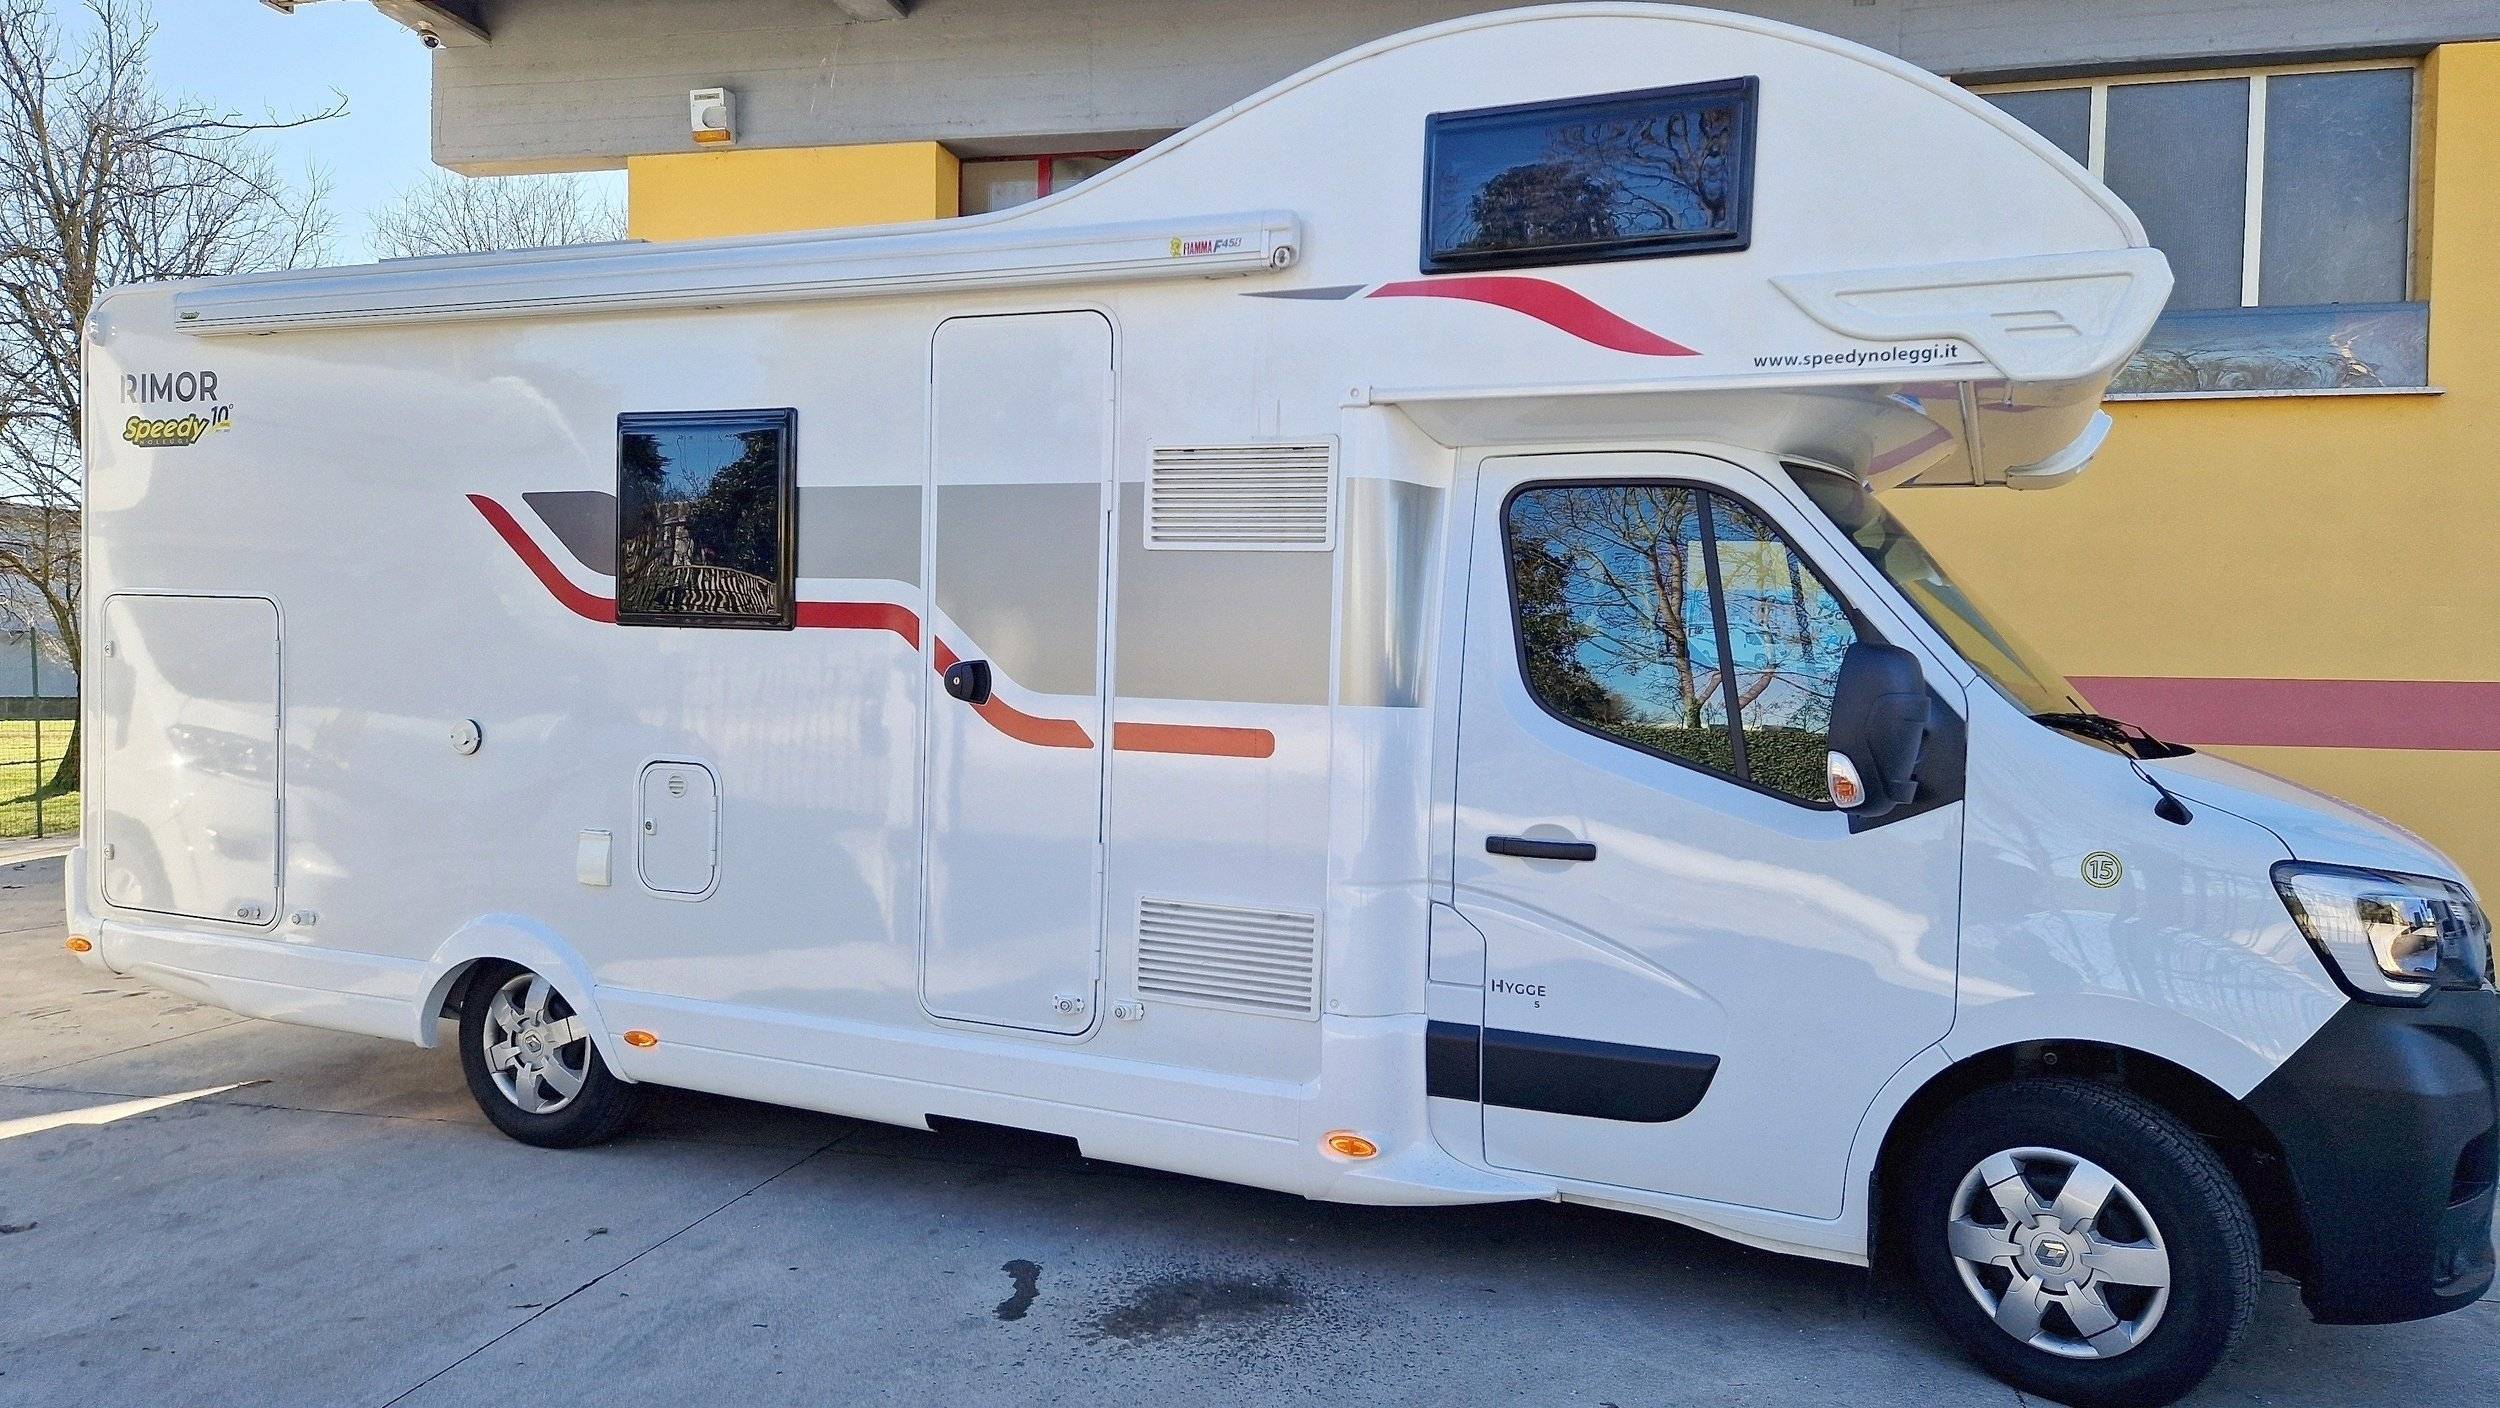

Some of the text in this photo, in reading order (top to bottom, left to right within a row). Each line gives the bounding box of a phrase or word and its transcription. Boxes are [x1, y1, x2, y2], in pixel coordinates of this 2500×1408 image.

[1183, 240, 1212, 255] FIAMMA
[1754, 344, 1958, 368] www.speedynoleggi.it
[120, 370, 218, 403] RIMOR
[123, 413, 209, 444] Speedy
[2089, 859, 2114, 880] 15
[1491, 978, 1546, 997] HYGGE
